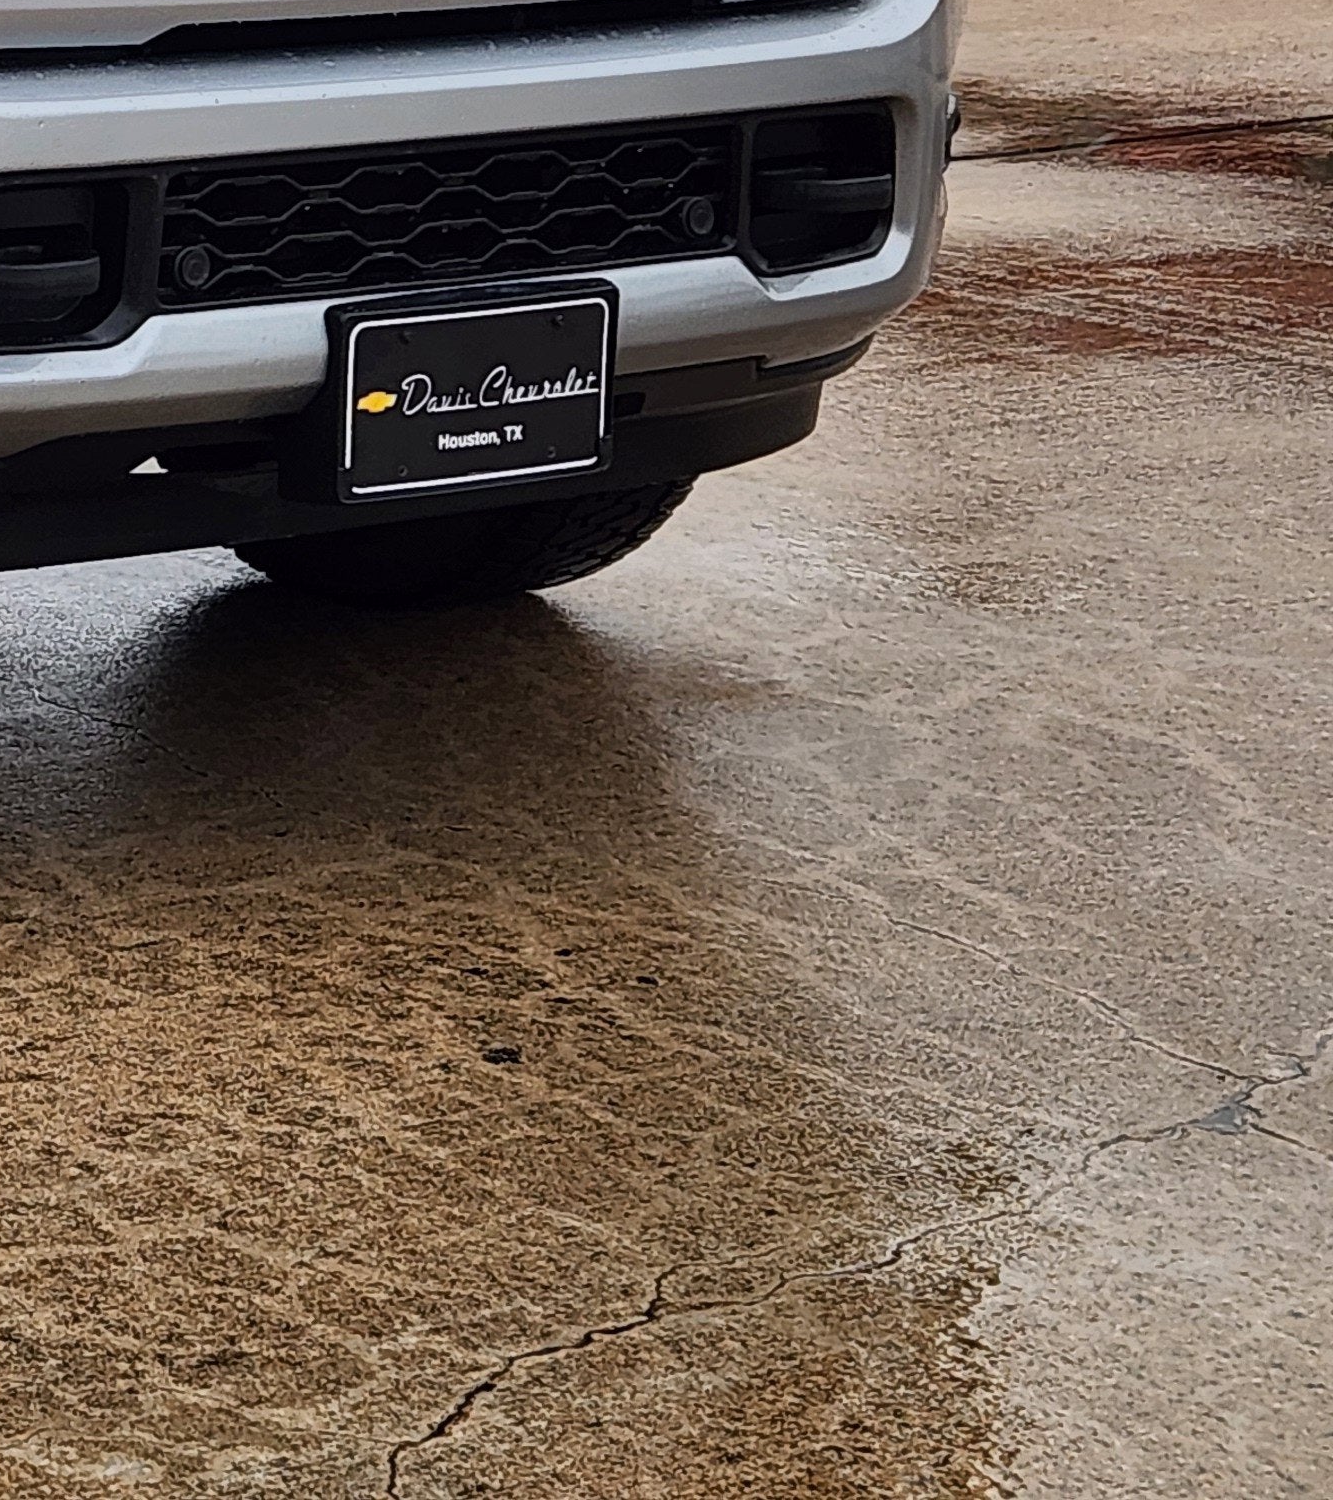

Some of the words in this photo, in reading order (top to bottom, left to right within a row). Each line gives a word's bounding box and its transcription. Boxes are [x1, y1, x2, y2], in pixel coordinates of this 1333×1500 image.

[401, 373, 478, 416] Davis
[479, 365, 600, 407] Chevrolet
[438, 430, 501, 451] Houston,
[503, 424, 523, 443] TX
